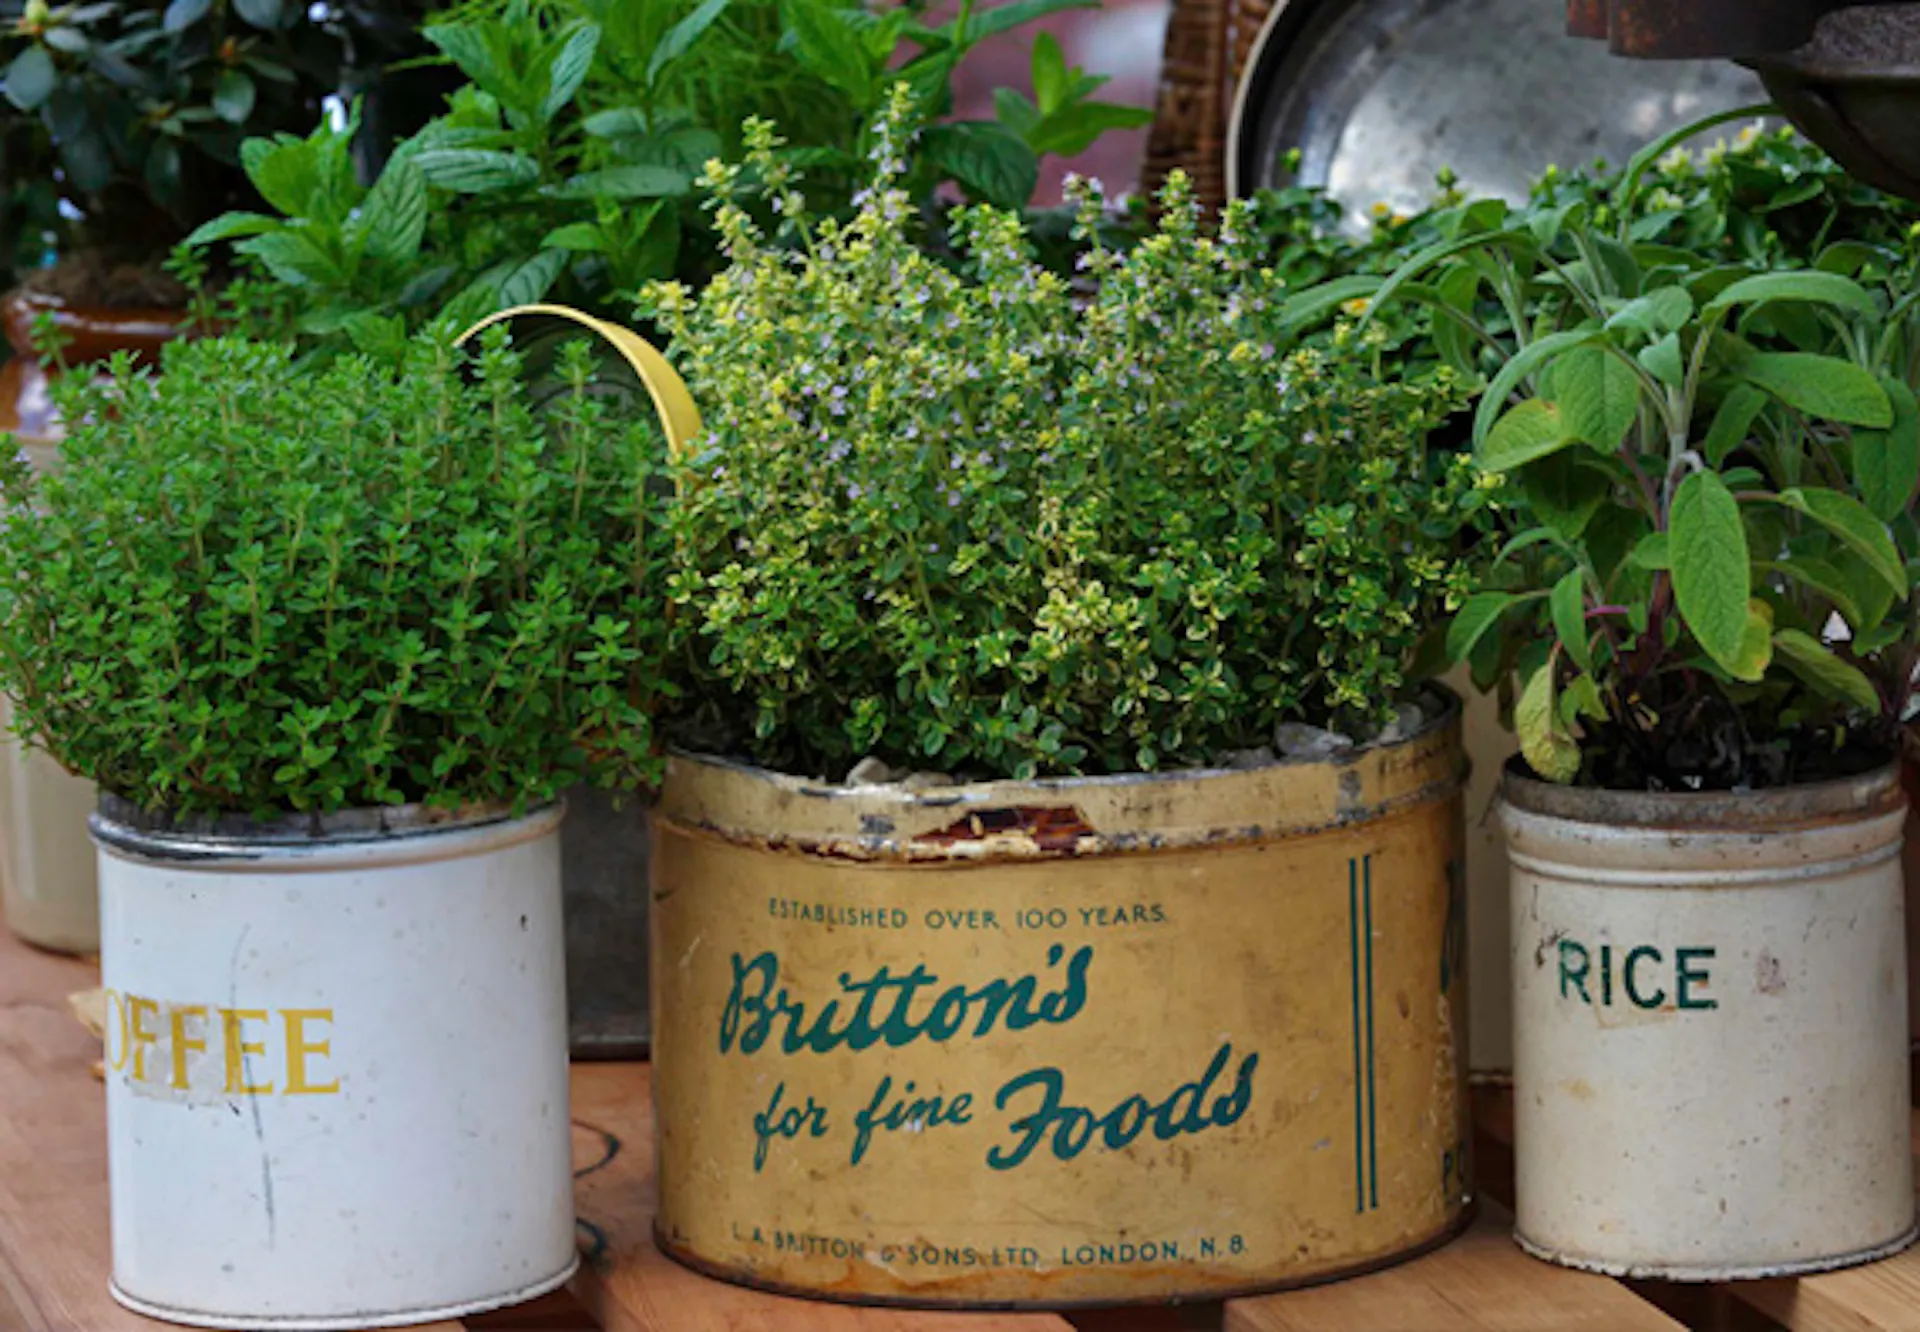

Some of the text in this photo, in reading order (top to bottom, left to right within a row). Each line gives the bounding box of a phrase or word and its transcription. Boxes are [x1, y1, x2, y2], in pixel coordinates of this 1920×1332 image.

[768, 897, 909, 929] ESTABLISHED
[924, 908, 1000, 929] OVER
[1016, 907, 1067, 929] 100
[719, 943, 1093, 1055] Britton's
[1557, 938, 1718, 1010] RICE
[754, 1042, 1259, 1174] for fine Foods
[773, 1231, 866, 1259] BRITTON
[907, 1245, 977, 1265] SONS
